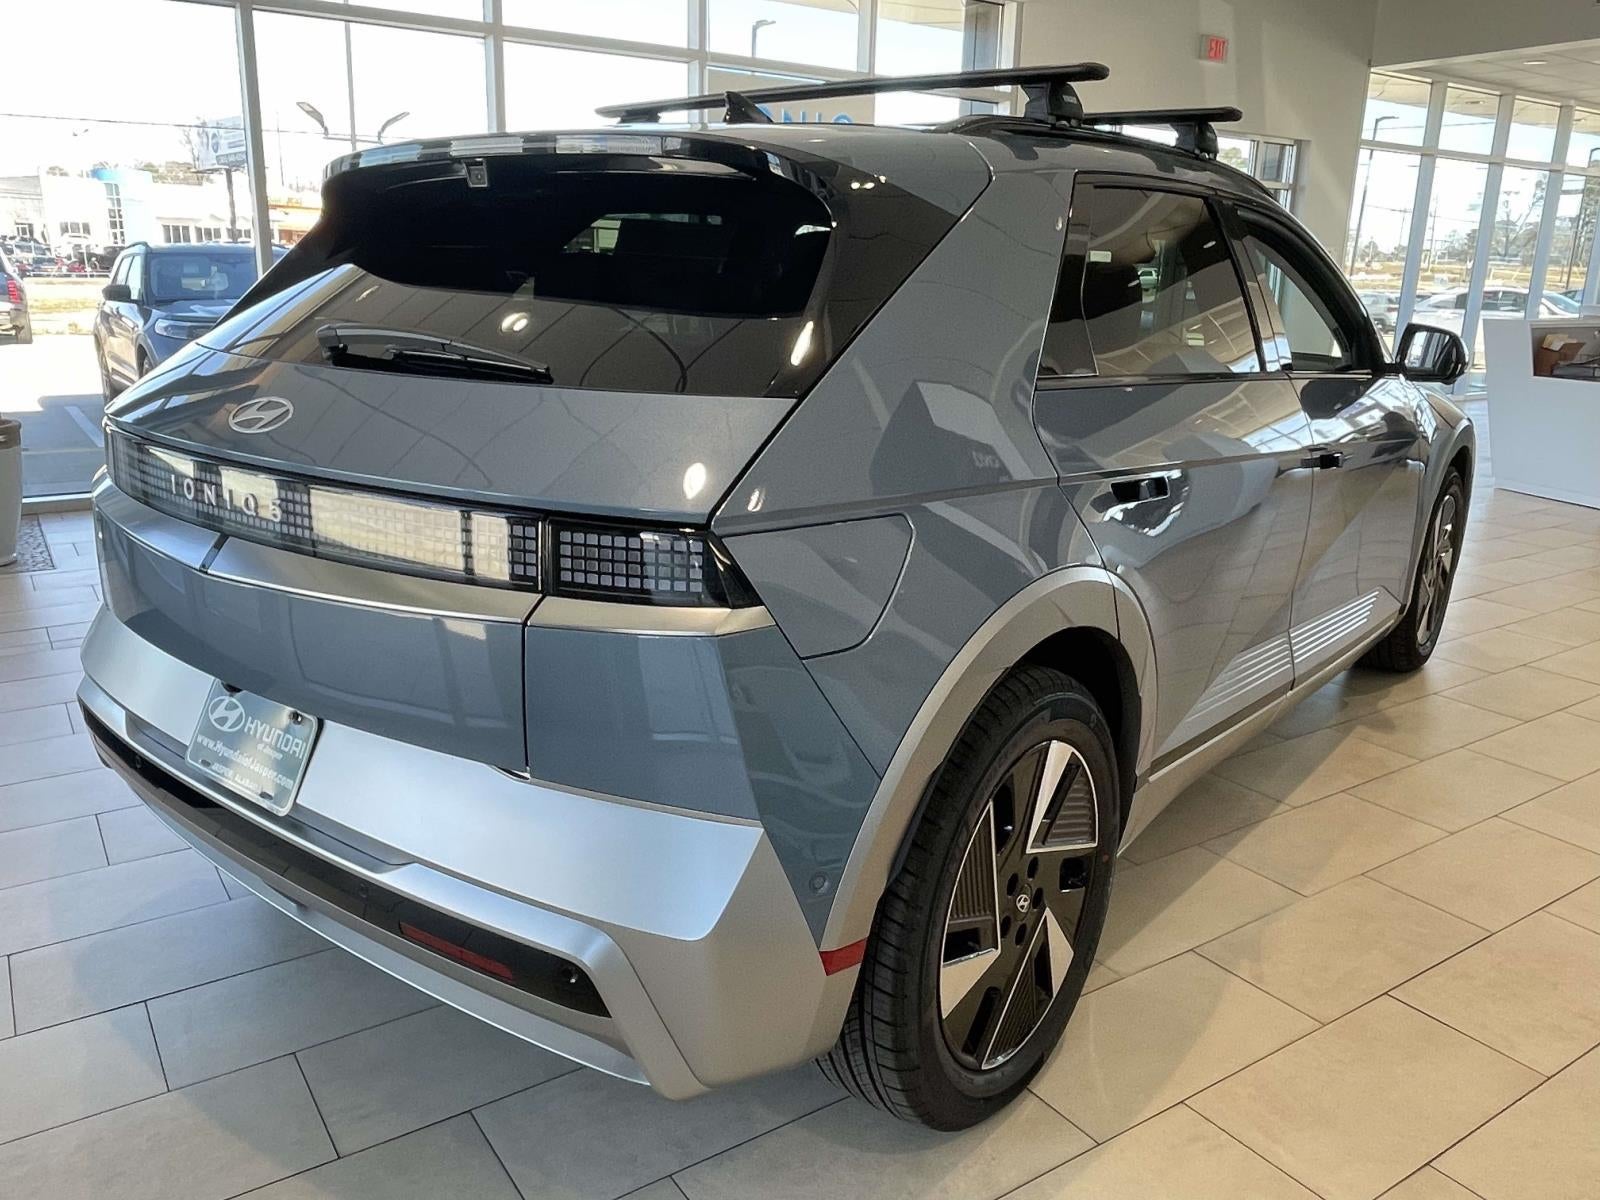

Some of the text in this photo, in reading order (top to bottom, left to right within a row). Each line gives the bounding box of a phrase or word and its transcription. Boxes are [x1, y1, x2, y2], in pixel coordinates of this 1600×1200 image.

[171, 474, 281, 522] IONIQ 5
[244, 716, 306, 759] HYUNDAI
